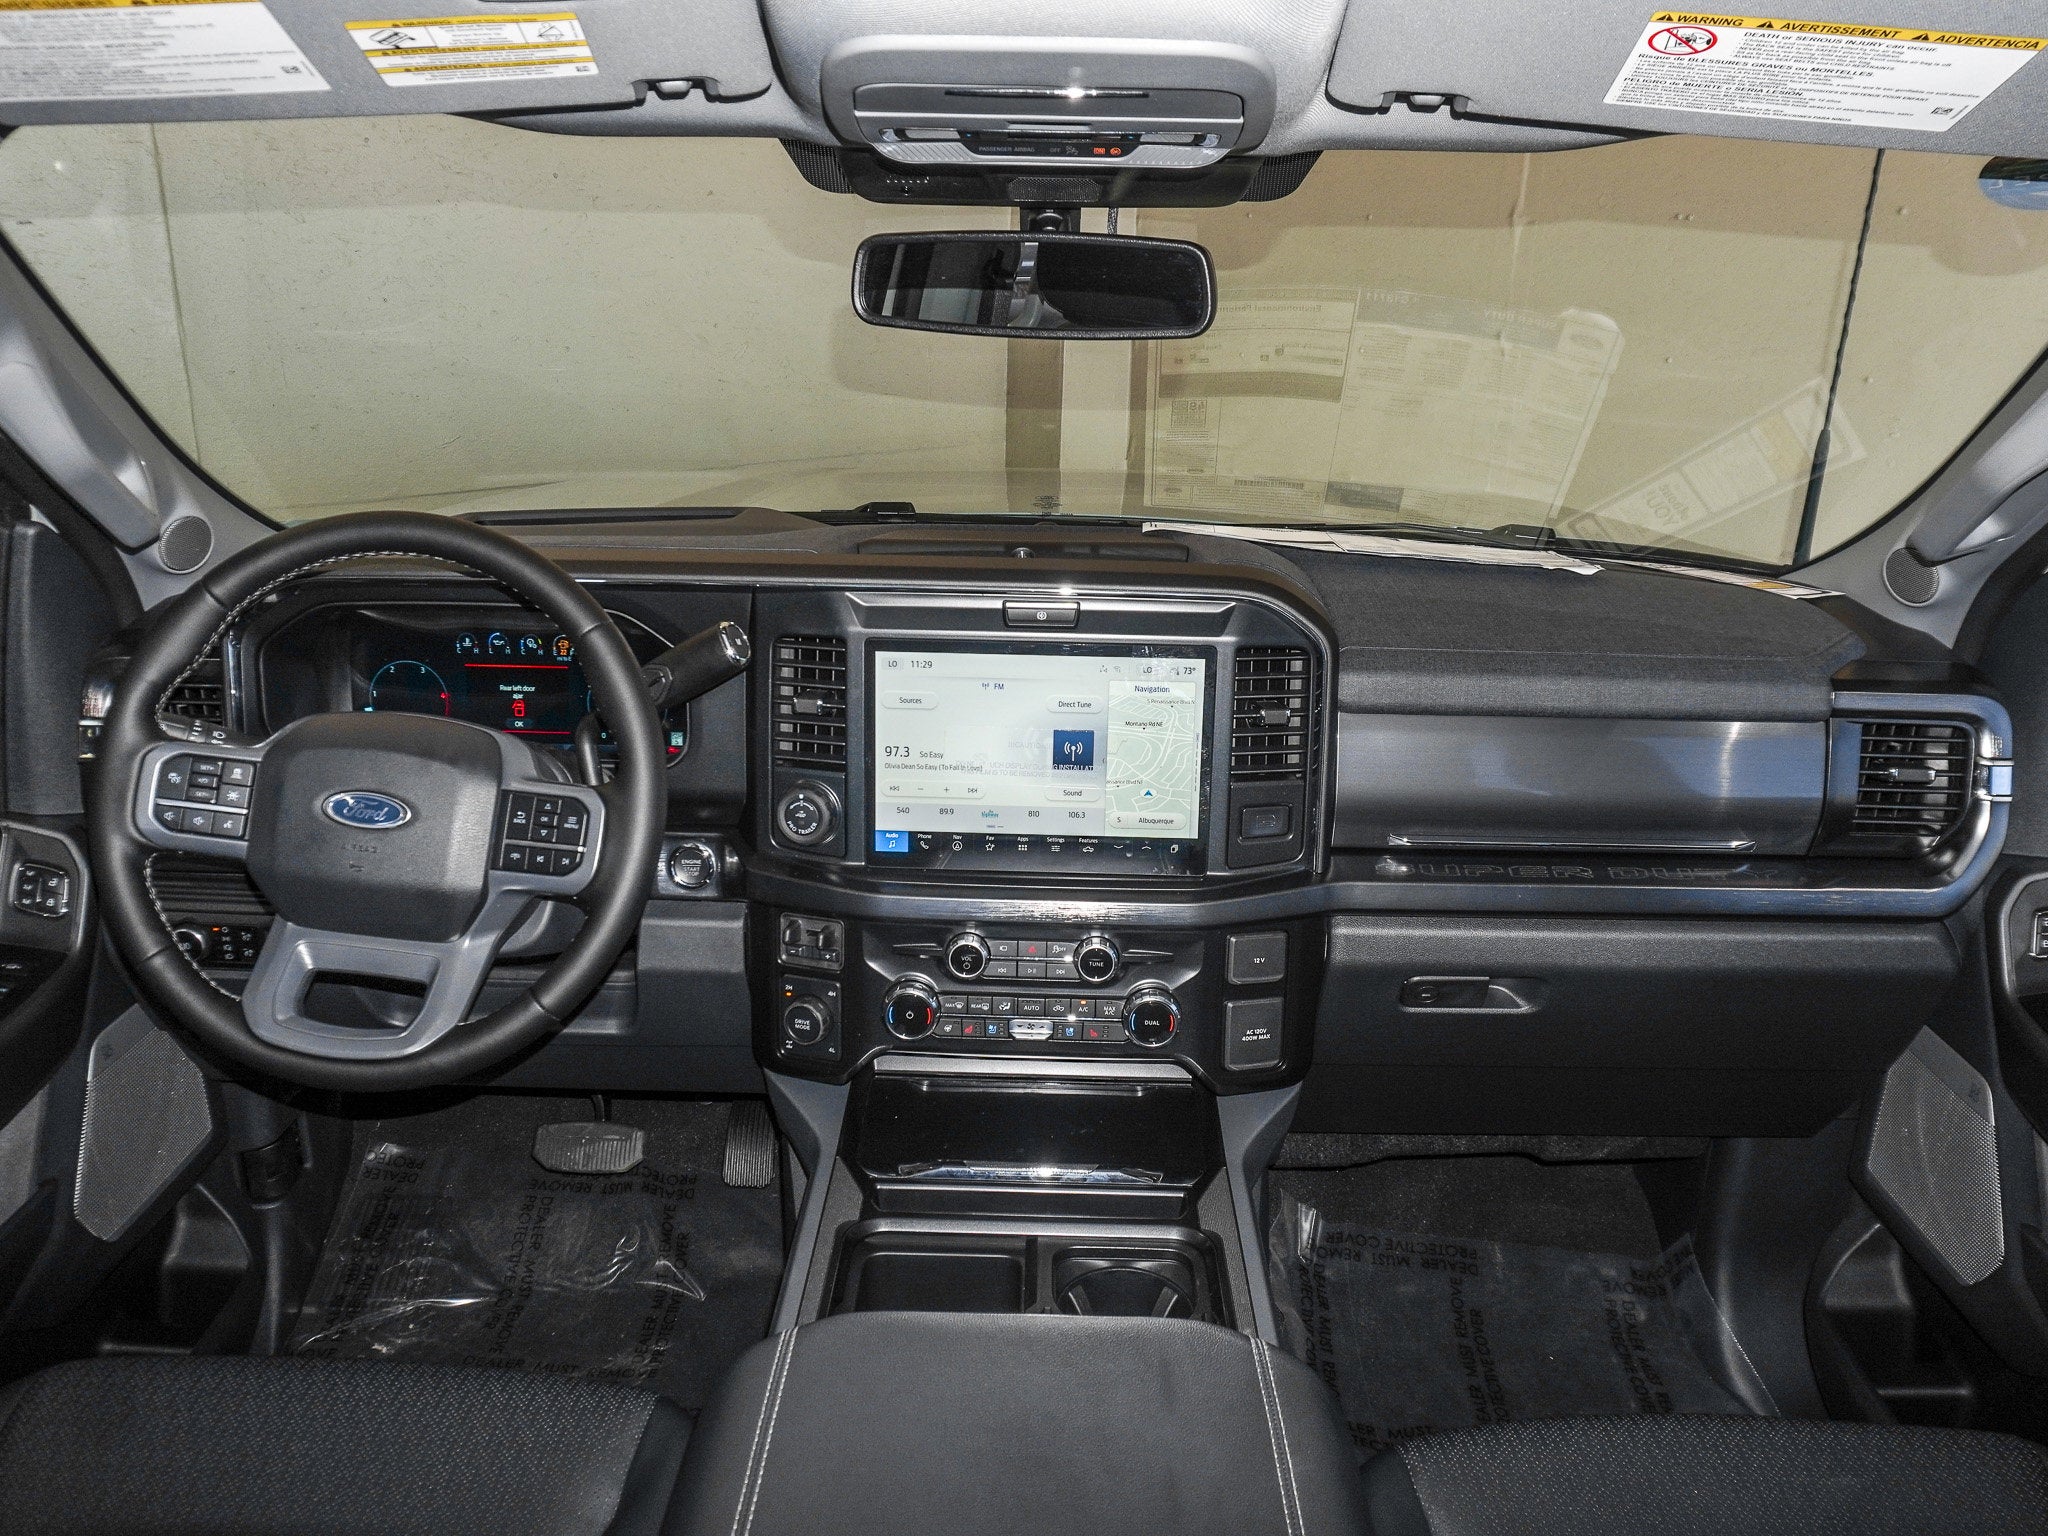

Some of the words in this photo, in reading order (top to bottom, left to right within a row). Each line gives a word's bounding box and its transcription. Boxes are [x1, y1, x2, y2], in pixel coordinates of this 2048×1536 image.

[1677, 14, 1744, 27] WARNING
[1780, 22, 1903, 39] AVERTISSEMENT
[1744, 31, 1780, 39] DEATH
[1795, 35, 1842, 44] SERIOUS
[1845, 39, 1885, 48] INJURY
[1934, 33, 2040, 50] ADVERTENCIA
[1638, 53, 1671, 62] Risque
[1687, 57, 1749, 67] BLESSURES
[1751, 62, 1793, 71] GRAVES
[1810, 67, 1874, 77] MORTELLES
[1623, 77, 1668, 87] PELIGRO
[1687, 81, 1724, 91] MUERTE
[1733, 86, 1764, 95] SERIA
[390, 665, 395, 673] 2
[420, 666, 425, 674] 3
[888, 660, 898, 668] LO
[911, 660, 933, 669] 11:29
[1143, 666, 1152, 674] LO
[1183, 666, 1197, 675] 73°
[993, 682, 1005, 690] FM
[1134, 685, 1170, 694] Navigation
[899, 696, 922, 704] Sources
[1076, 701, 1092, 709] Tune
[884, 745, 910, 758] 97.3
[929, 751, 944, 760] Easy
[924, 764, 938, 772] Easy
[1063, 789, 1082, 797] Sound
[939, 807, 955, 815] 89.9
[1068, 811, 1086, 819] 106.3
[787, 820, 797, 831] PRO
[798, 822, 818, 834] TRAILER
[1138, 817, 1175, 825] Albuquerque
[1017, 835, 1029, 843] Apps
[1046, 836, 1065, 844] Settings
[1375, 863, 1595, 880] SUPER
[795, 1023, 811, 1031] MODE
[363, 1166, 419, 1184] DEALER
[530, 1178, 593, 1194] REMOVE
[601, 1180, 634, 1195] MUST
[641, 1181, 696, 1200] DEALER
[530, 1195, 554, 1251] DEALER
[503, 1194, 538, 1286] PROTECTIVE
[1325, 1230, 1381, 1249] COVER
[1385, 1236, 1479, 1261] PROTECTIVE
[1371, 1251, 1411, 1268] MUST
[1420, 1257, 1479, 1277] DEALER
[517, 1259, 536, 1302] MUST
[1312, 1262, 1331, 1311] DEALER
[1450, 1276, 1469, 1339] REMOVE
[1469, 1308, 1491, 1355] COVER
[1458, 1343, 1480, 1379] MUST
